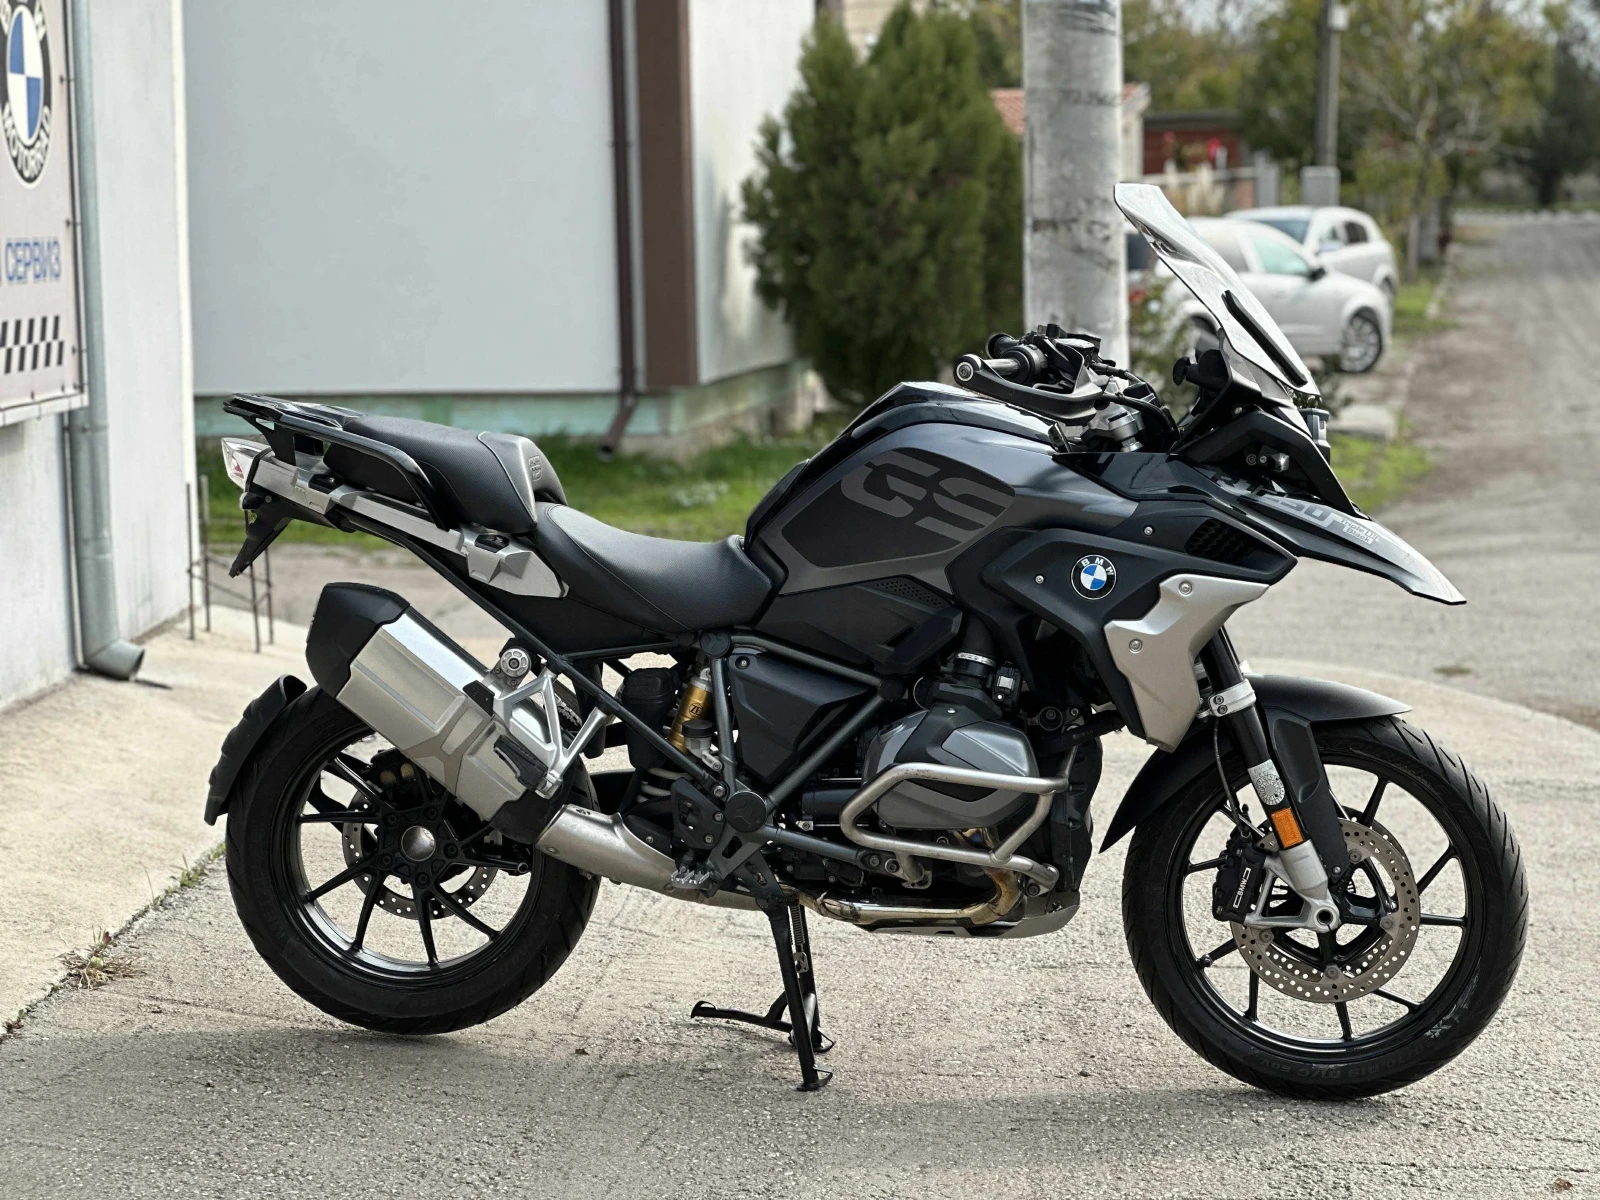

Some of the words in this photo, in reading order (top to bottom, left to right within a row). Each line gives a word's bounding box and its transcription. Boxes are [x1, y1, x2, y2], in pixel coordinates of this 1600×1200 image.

[0, 0, 47, 40] BW
[4, 240, 62, 281] СЕРВИЗ
[1081, 557, 1114, 576] BMW
[690, 704, 702, 715] ZF
